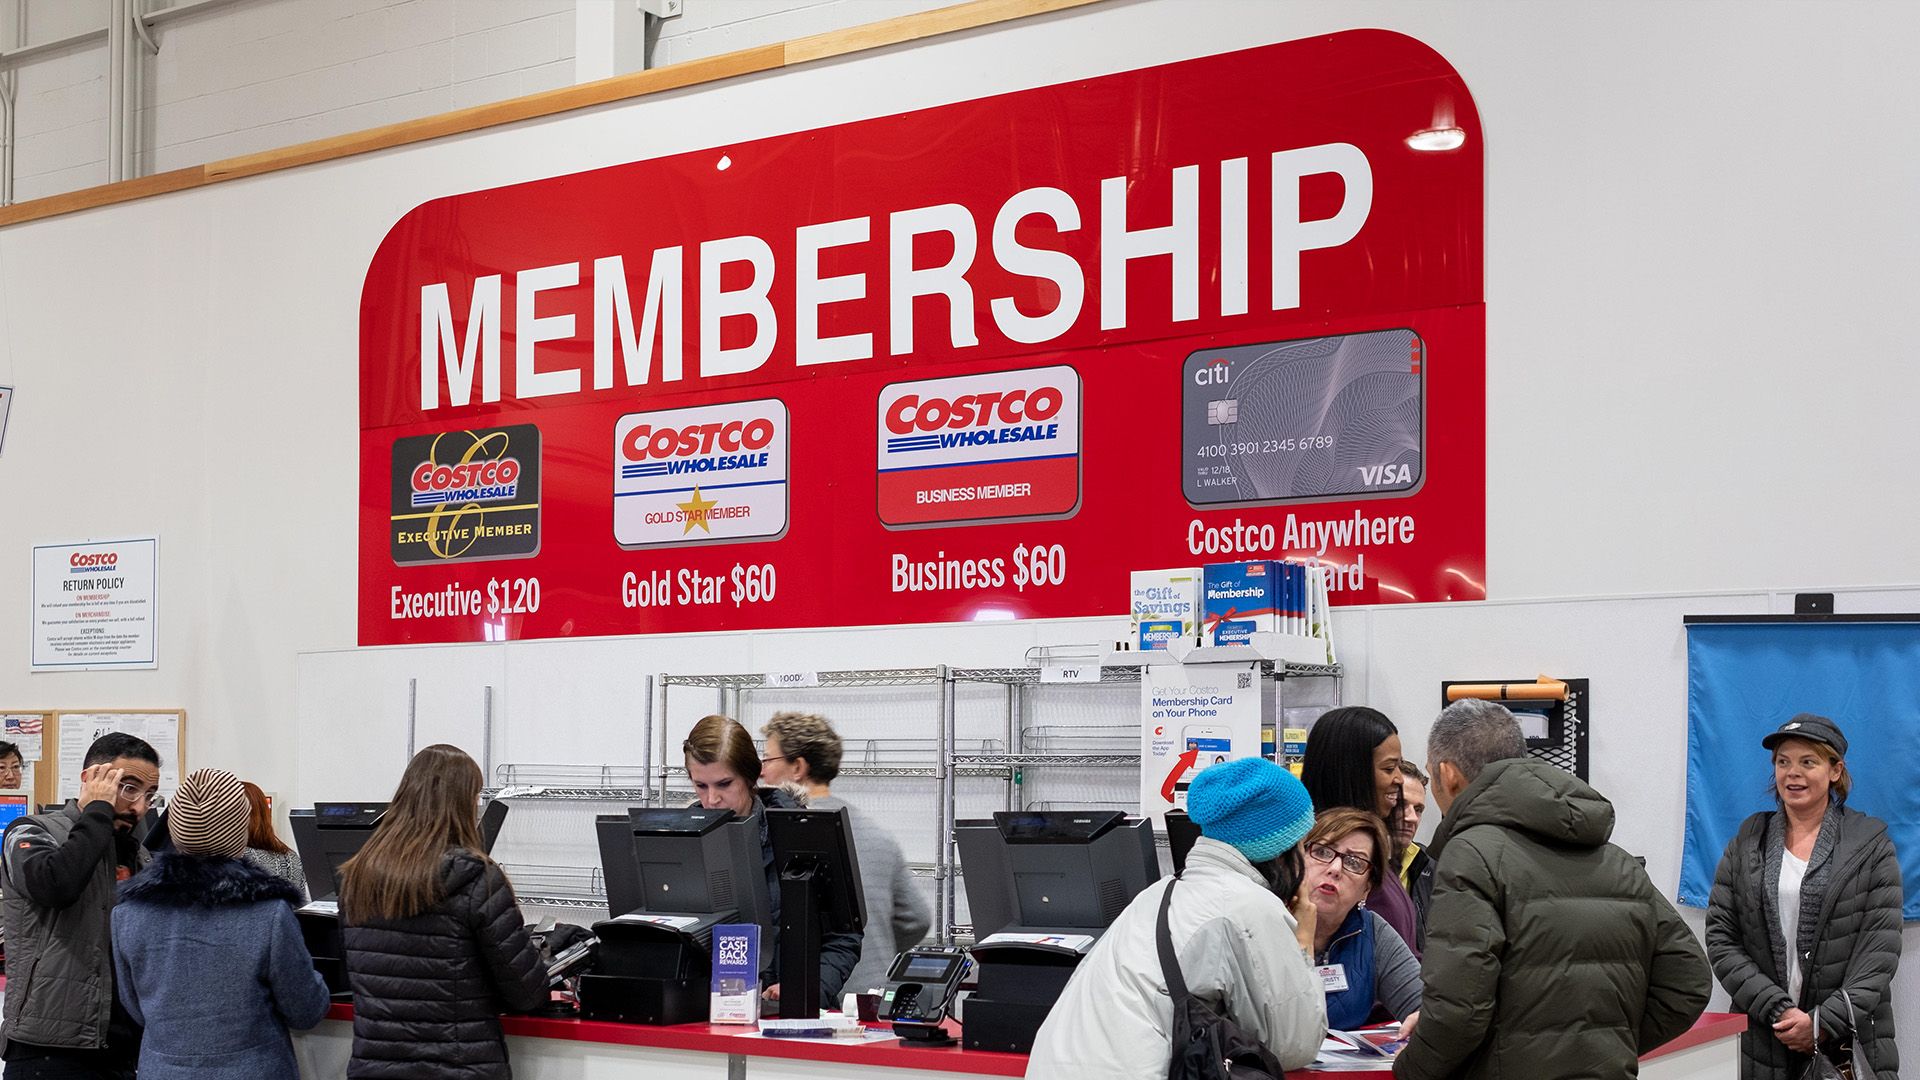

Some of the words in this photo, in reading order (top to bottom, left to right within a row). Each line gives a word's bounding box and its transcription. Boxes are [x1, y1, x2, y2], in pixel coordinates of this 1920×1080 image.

[420, 142, 1373, 410] MEMBERSHIP
[1195, 360, 1229, 386] citi
[885, 387, 1063, 435] COSTCO
[622, 418, 774, 462] COSTCO
[939, 424, 1059, 449] WHOLESALE
[1197, 445, 1227, 458] 4100
[1230, 442, 1260, 456] 3901
[1263, 439, 1296, 453] 2345
[1299, 436, 1333, 450] 6789
[666, 453, 769, 475] WHOLESALE
[1211, 466, 1230, 475] 12/18
[412, 461, 519, 491] COSTCO
[1204, 477, 1237, 487] WALKER
[1357, 463, 1412, 486] VISA
[444, 485, 516, 501] WHOLESALE
[916, 486, 976, 504] BUSINESS
[977, 483, 1031, 499] MEMBER
[644, 511, 674, 524] GOLD
[675, 509, 703, 523] STAR
[704, 505, 751, 520] MEMBER
[398, 527, 469, 544] EXECUTIVE
[475, 522, 532, 537] MEMBER
[1188, 518, 1275, 554] Costco
[1282, 509, 1415, 556] Anywhere
[70, 552, 118, 567] COSTCO
[84, 565, 116, 573] WHOLESALE
[892, 551, 1005, 592] Business
[1012, 543, 1066, 592] $60
[1305, 554, 1364, 591] ard
[63, 579, 94, 592] RETURN
[97, 577, 125, 590] POLICY
[622, 568, 674, 608] Gold
[678, 569, 725, 604] Star
[731, 562, 776, 607] $60
[1146, 587, 1173, 600] Gift
[1173, 592, 1180, 600] of
[1208, 587, 1265, 599] Membership
[391, 581, 481, 619] Executive
[487, 577, 541, 618] $120
[1134, 601, 1191, 617] Savings
[1143, 631, 1180, 641] MEMBERSHIP
[1063, 670, 1079, 678] RTV
[1152, 687, 1167, 696] Get
[1169, 686, 1187, 695] Your
[1189, 685, 1219, 694] Costco
[1152, 697, 1209, 707] Membership
[1210, 696, 1233, 705] Card
[1166, 709, 1186, 717] Your
[1188, 708, 1217, 717] Phone
[719, 941, 748, 950] CASH
[719, 950, 748, 960] BACK
